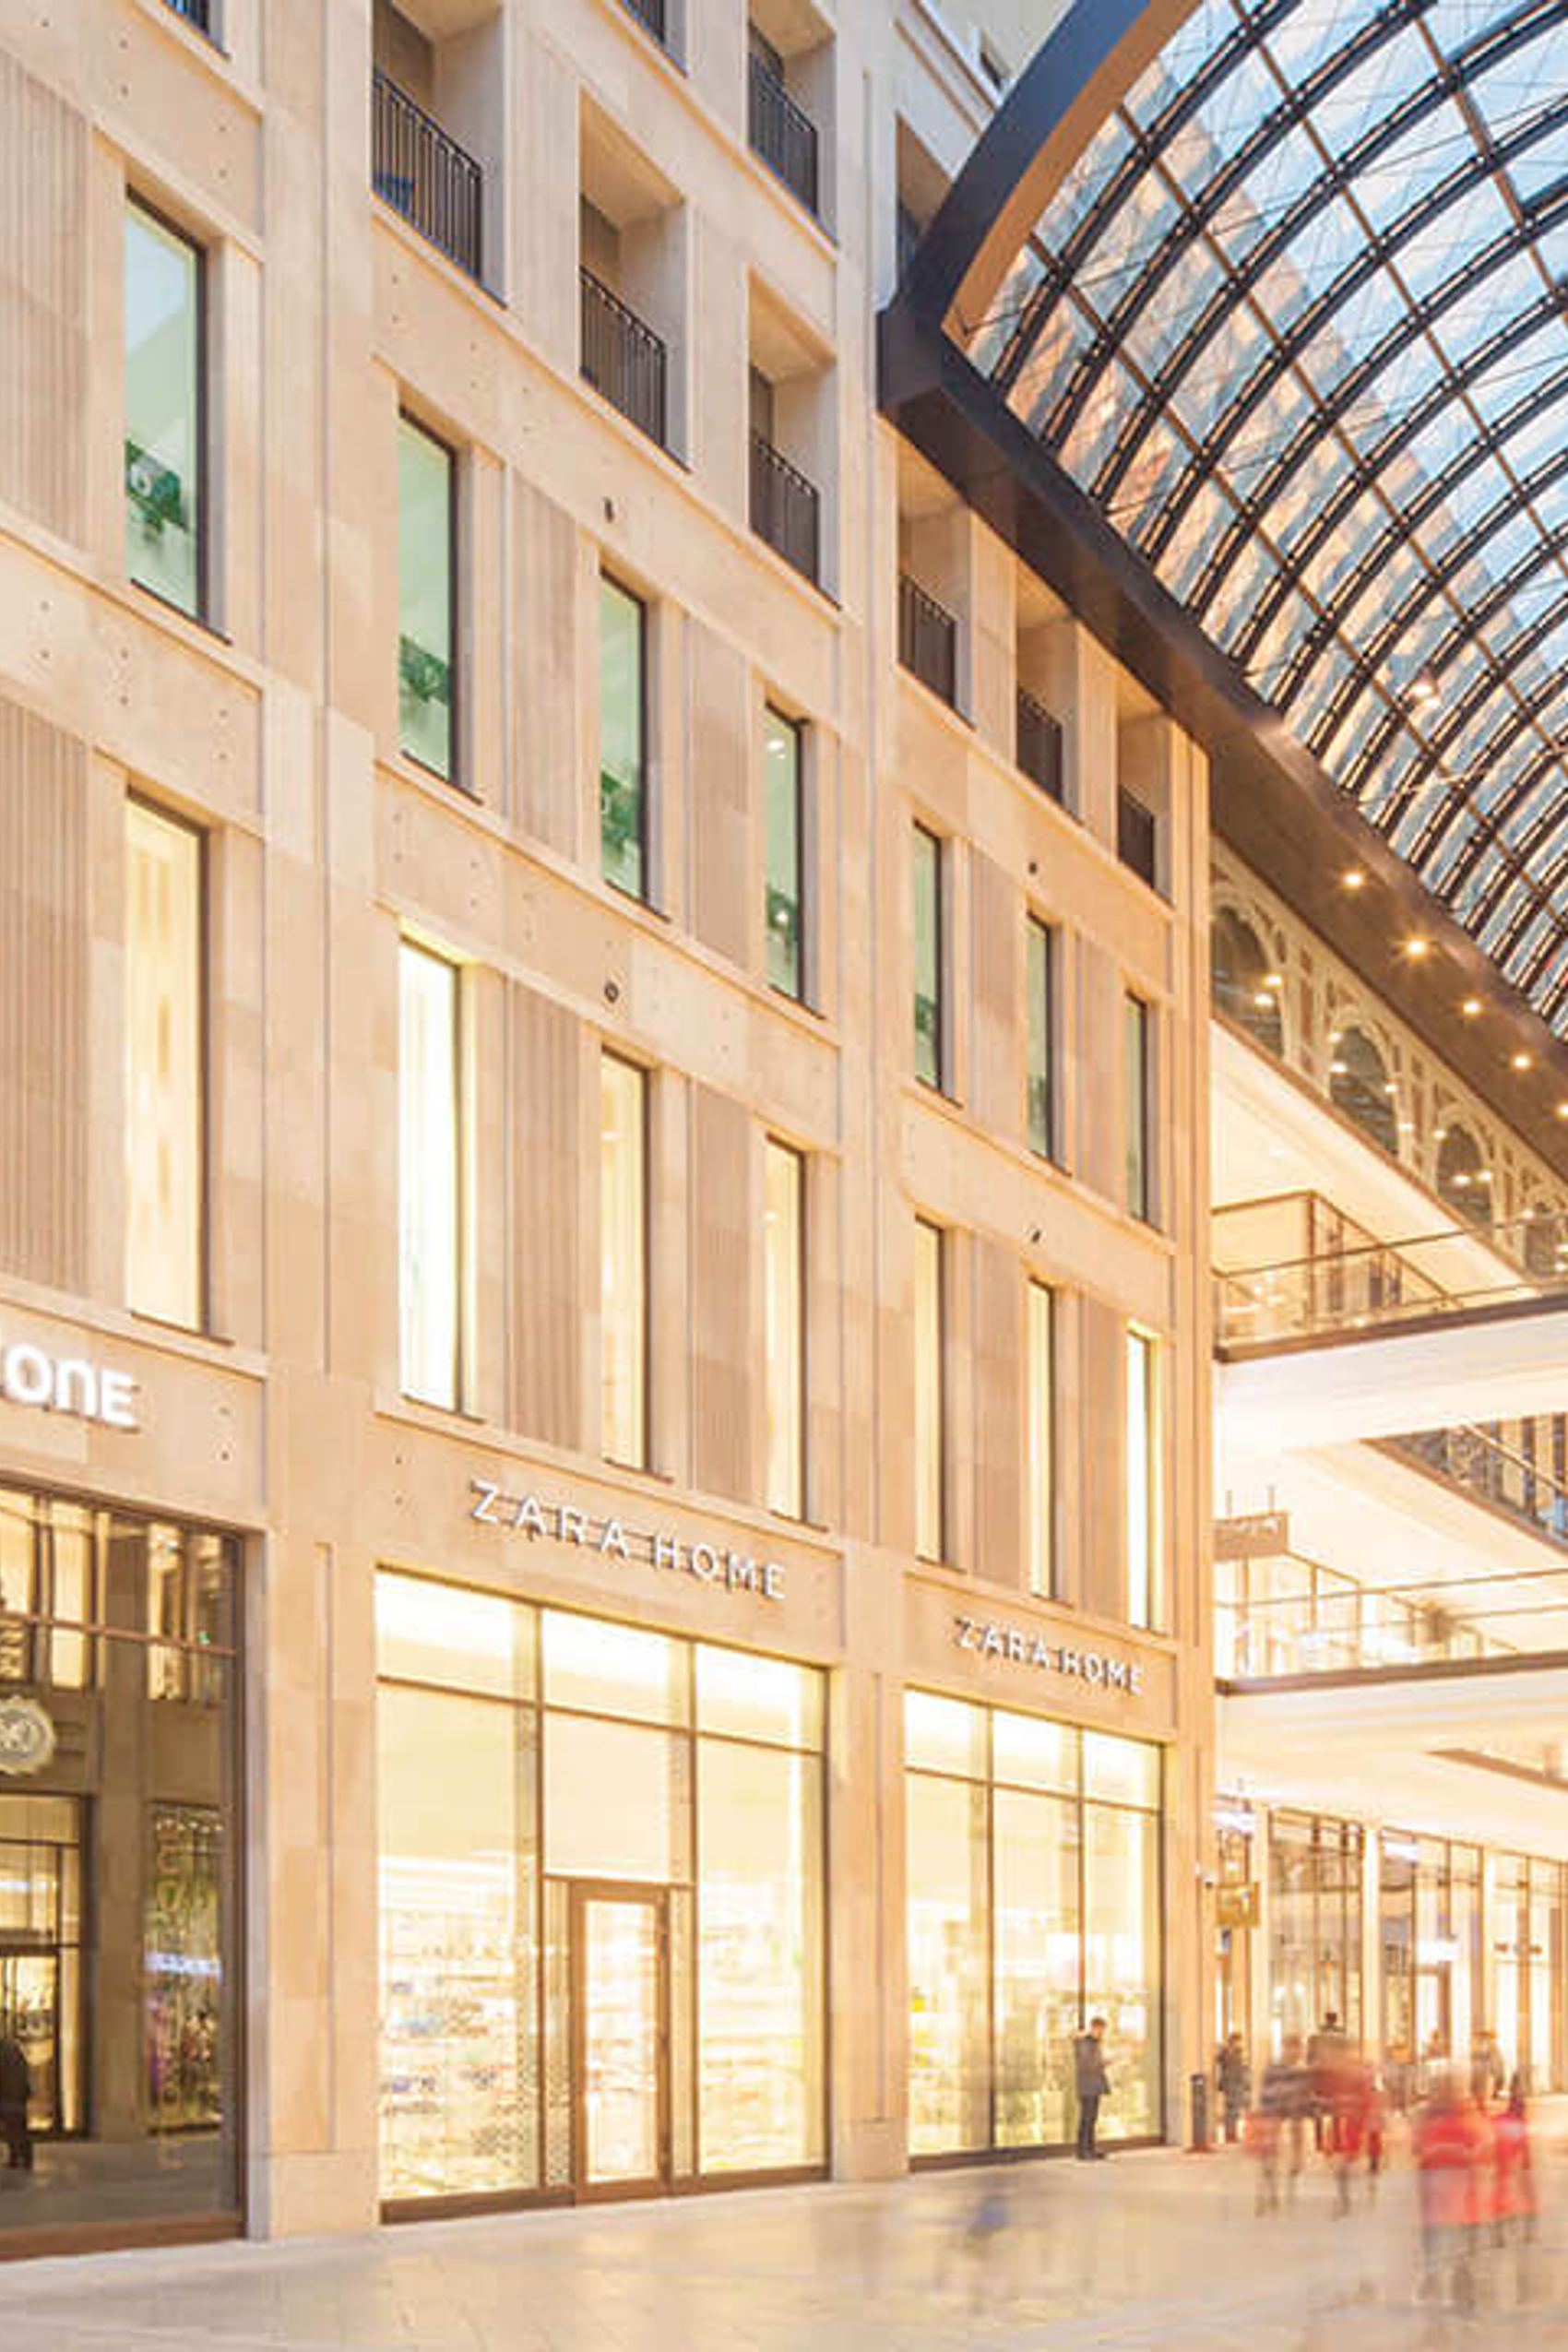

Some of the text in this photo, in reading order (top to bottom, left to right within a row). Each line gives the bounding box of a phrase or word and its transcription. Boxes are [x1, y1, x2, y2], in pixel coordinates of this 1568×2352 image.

[469, 1479, 786, 1600] ZARA HOME
[955, 1617, 1146, 1694] ZARA HOME
